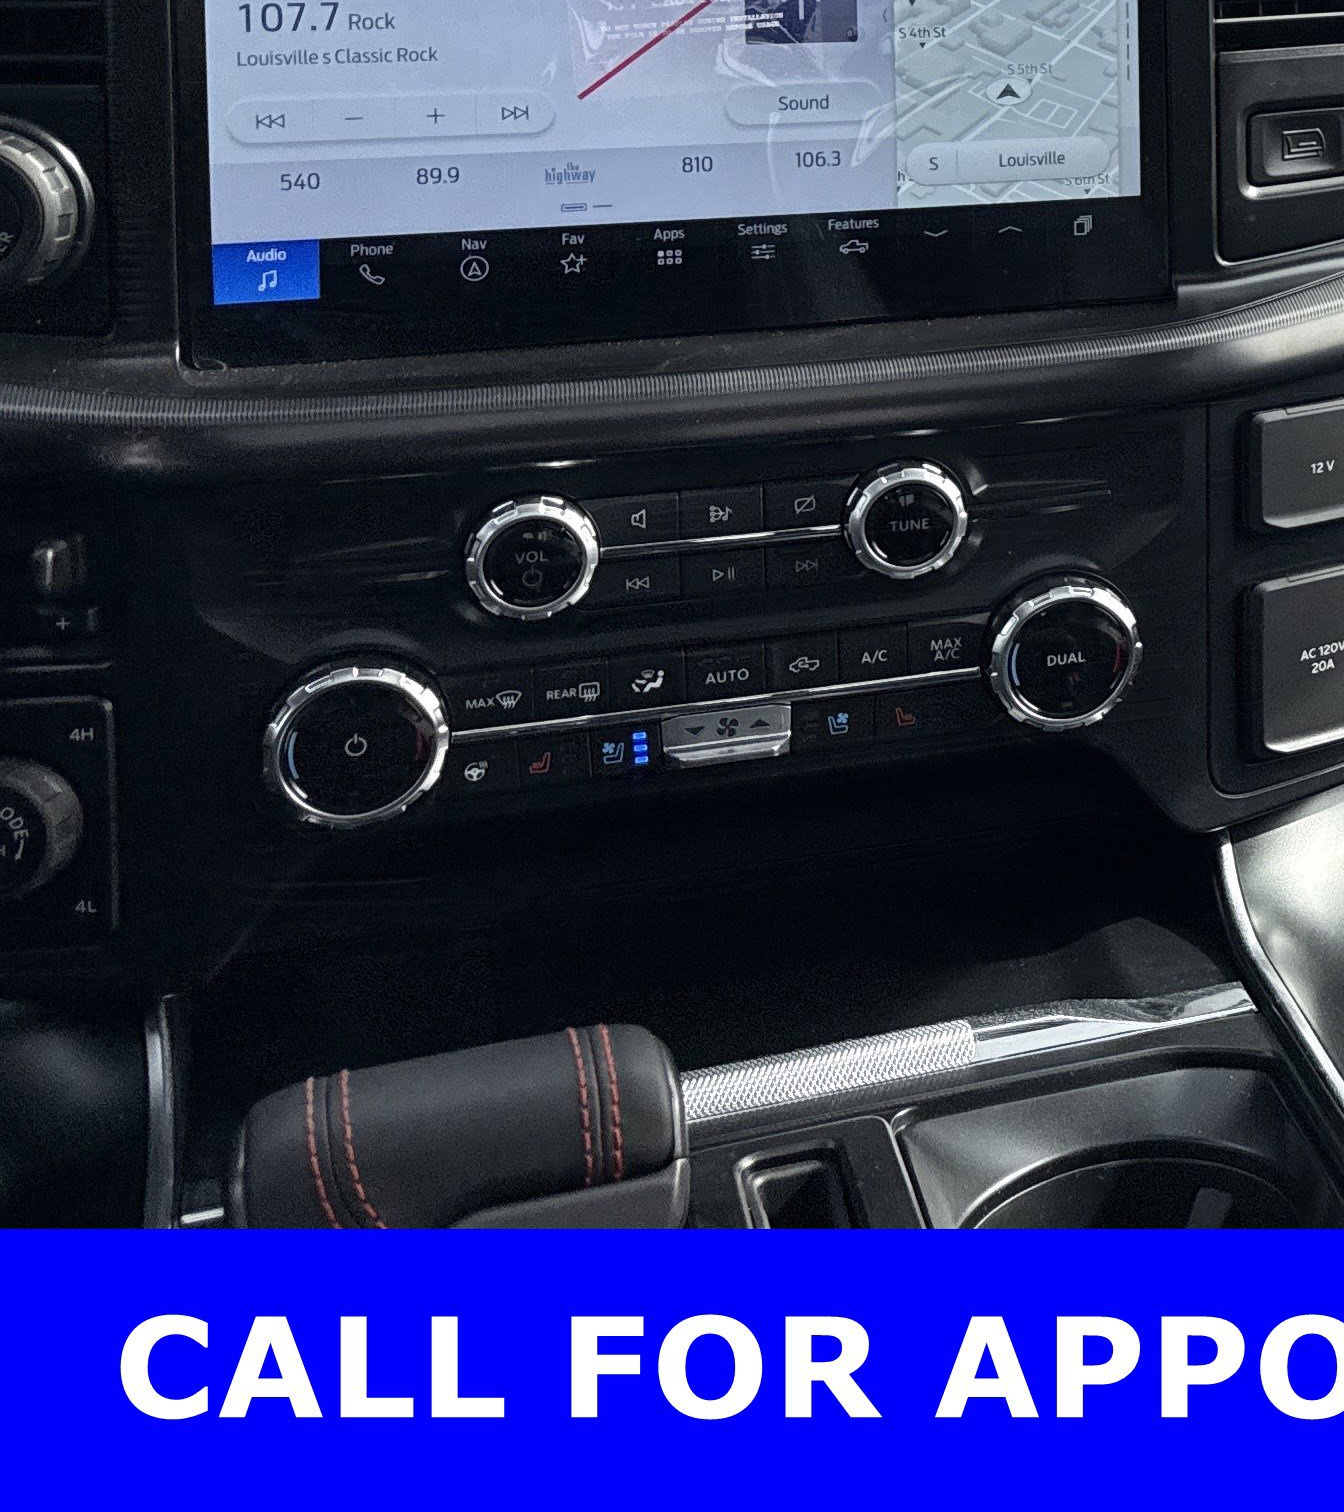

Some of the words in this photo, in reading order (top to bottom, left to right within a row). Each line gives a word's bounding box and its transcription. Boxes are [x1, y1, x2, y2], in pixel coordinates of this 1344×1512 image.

[237, 1, 340, 34] 107.7
[347, 12, 396, 31] Rock
[899, 28, 907, 39] S
[909, 27, 931, 39] 4th
[933, 27, 947, 38] St
[236, 46, 320, 68] Louisville
[334, 46, 394, 66] Classic
[396, 45, 439, 64] Rock
[1007, 64, 1015, 75] S
[1017, 63, 1038, 75] 5th
[1040, 63, 1053, 74] St
[778, 93, 830, 112] Sound
[566, 162, 580, 171] the
[681, 155, 714, 174] 810
[794, 150, 842, 169] 106.3
[929, 157, 939, 171] S
[998, 151, 1066, 168] Louisville
[280, 173, 321, 192] 540
[416, 166, 461, 186] 89.9
[544, 168, 597, 185] highway
[737, 221, 788, 239] Settings
[827, 216, 880, 232] Features
[561, 233, 586, 246] Fav
[653, 227, 685, 244] Apps
[350, 243, 393, 257] Phone
[461, 238, 488, 251] Nav
[246, 247, 287, 263] Audio
[1310, 461, 1325, 475] 12
[1326, 459, 1336, 472] V
[889, 518, 931, 533] TUNE
[515, 550, 549, 564] VOL
[930, 637, 963, 651] MAX
[861, 649, 888, 665] A/C
[933, 648, 960, 661] A/C
[1046, 652, 1086, 668] DUAL
[1300, 646, 1318, 662] AC
[1311, 659, 1336, 675] 20A
[705, 667, 750, 686] AUTO
[546, 688, 577, 701] REAR
[465, 696, 495, 710] MAX
[69, 728, 95, 742] 4H
[75, 899, 98, 914] 4L
